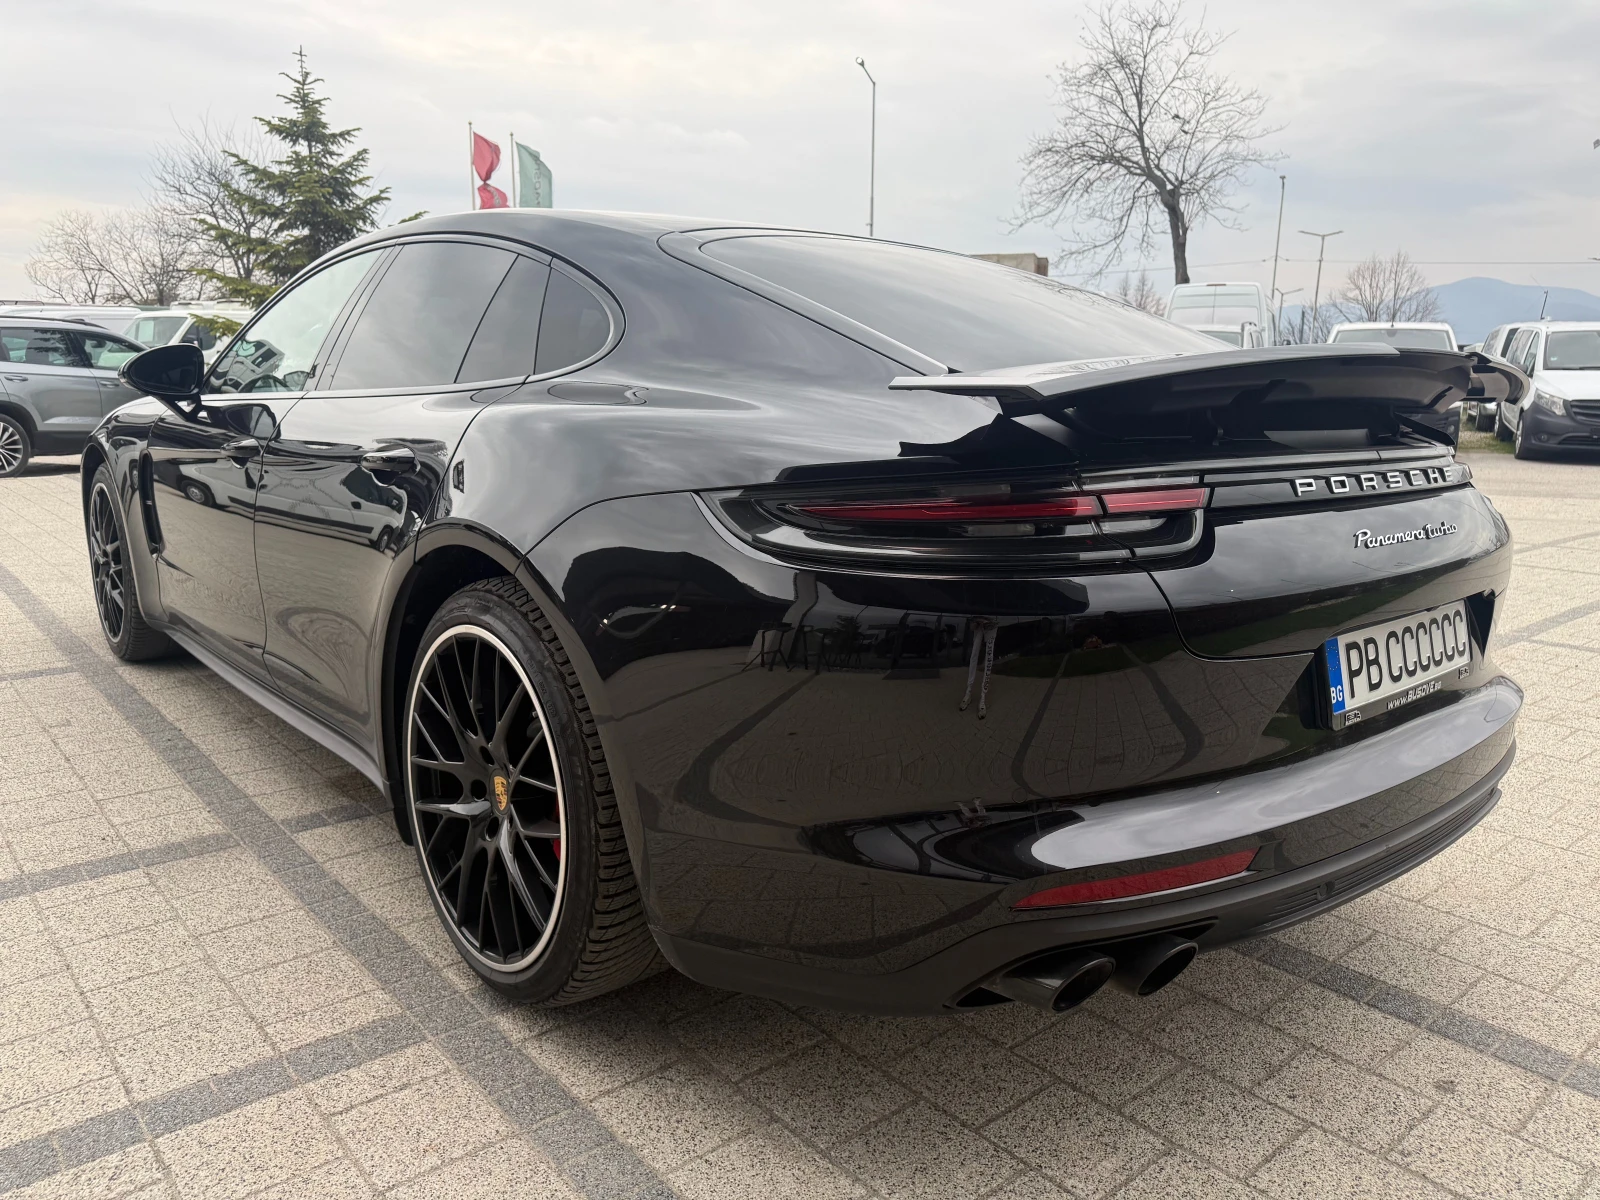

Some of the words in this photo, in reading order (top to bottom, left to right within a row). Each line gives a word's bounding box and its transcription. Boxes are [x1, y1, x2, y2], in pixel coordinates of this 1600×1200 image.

[1294, 467, 1453, 497] PORSCHE
[1354, 529, 1425, 548] Panamera
[1330, 685, 1343, 704] BG
